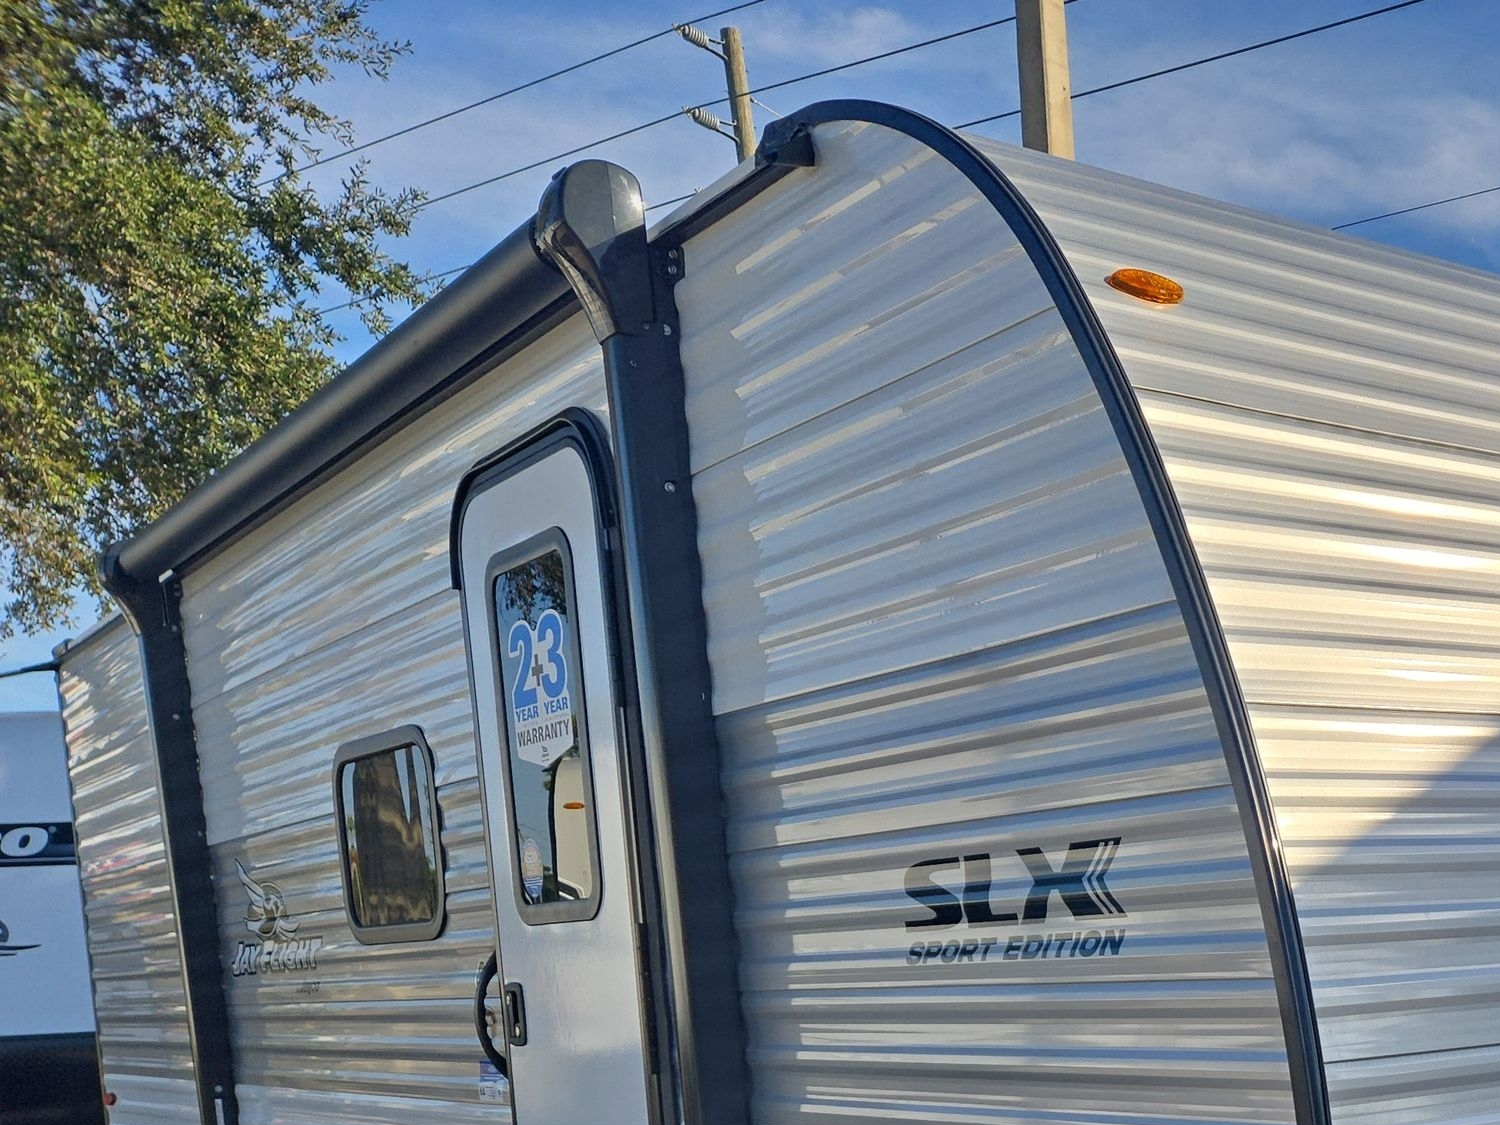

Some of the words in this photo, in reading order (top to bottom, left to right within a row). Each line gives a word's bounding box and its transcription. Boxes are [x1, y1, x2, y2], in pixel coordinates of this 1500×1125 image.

[516, 705, 539, 722] YEAR
[544, 697, 568, 715] YEAR
[517, 719, 570, 747] WARRANTY
[903, 836, 1128, 933] SLX
[232, 940, 261, 977] JAY
[260, 936, 323, 973] FLIGHT
[905, 936, 998, 966] SPORT
[1002, 928, 1126, 961] EDITION
